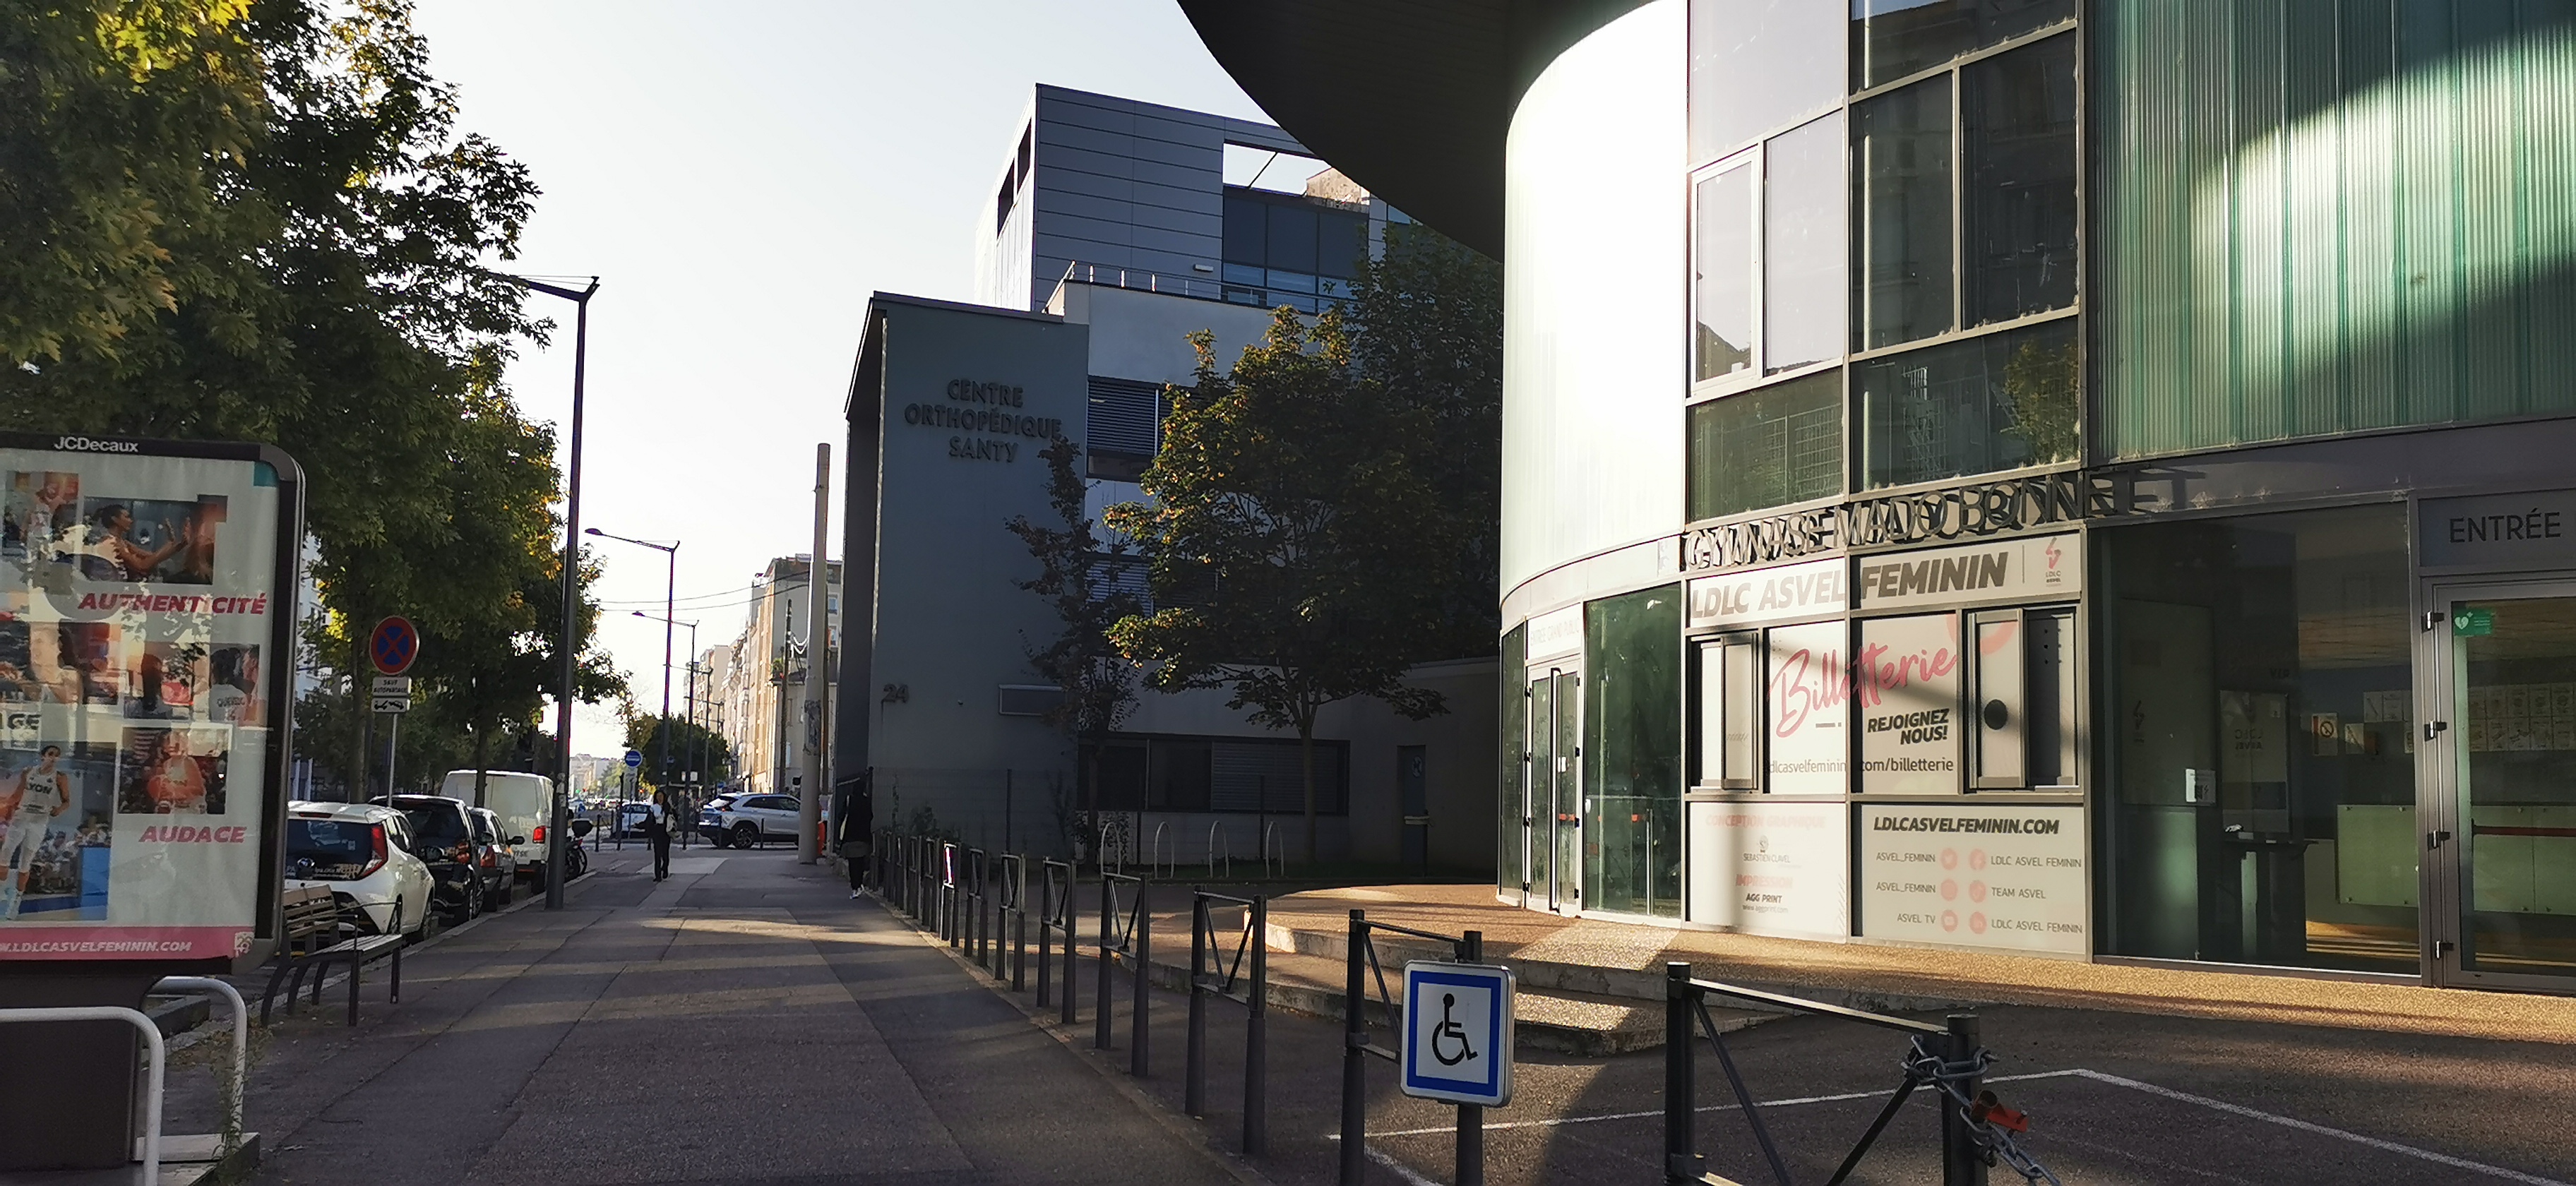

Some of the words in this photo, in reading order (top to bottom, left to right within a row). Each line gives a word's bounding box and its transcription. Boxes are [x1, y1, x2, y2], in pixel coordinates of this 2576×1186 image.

[947, 378, 1023, 408] CENTRE
[905, 403, 1062, 438] ORTHOPÉDIQUE
[54, 436, 138, 453] JCDecaux
[948, 436, 1019, 463] SANTY
[1685, 511, 1827, 570] GYMNASE
[1833, 490, 1948, 547] MADO
[2449, 507, 2562, 544] ENTRÉE
[1691, 582, 1751, 618] LDLC
[1758, 570, 1845, 611] ASVEL
[1861, 551, 2009, 600] FEMININ
[78, 592, 267, 615] AUTHENTICITÉ
[881, 683, 909, 704] 24
[1767, 642, 1957, 738] Billetterie
[1867, 707, 1950, 733] REJOIGNEZ
[1900, 724, 1948, 745] NOUS!
[1705, 815, 1763, 828] CONCEPTION
[1873, 817, 2060, 834] LDLCASVELFEMININ.COM
[138, 825, 247, 843] AUDACE
[1876, 852, 1936, 863] ASVEL_FEMININ
[1991, 856, 2012, 865] LDLC
[2015, 856, 2043, 867] ASVEL
[2046, 858, 2082, 868] FEMININ
[1736, 874, 1794, 889] IMPRESSION
[1876, 882, 1936, 893] ASVEL_FEMININ
[1746, 892, 1760, 902] AGG
[1761, 894, 1782, 904] PRINT
[1991, 887, 2015, 897] TEAM
[2018, 888, 2046, 899] ASVEL
[1897, 913, 1922, 923] ASVEL
[1924, 915, 1936, 924] TV
[1991, 919, 2012, 929] LDLC
[2016, 921, 2044, 931] ASVEL
[2047, 922, 2082, 933] FEMININ
